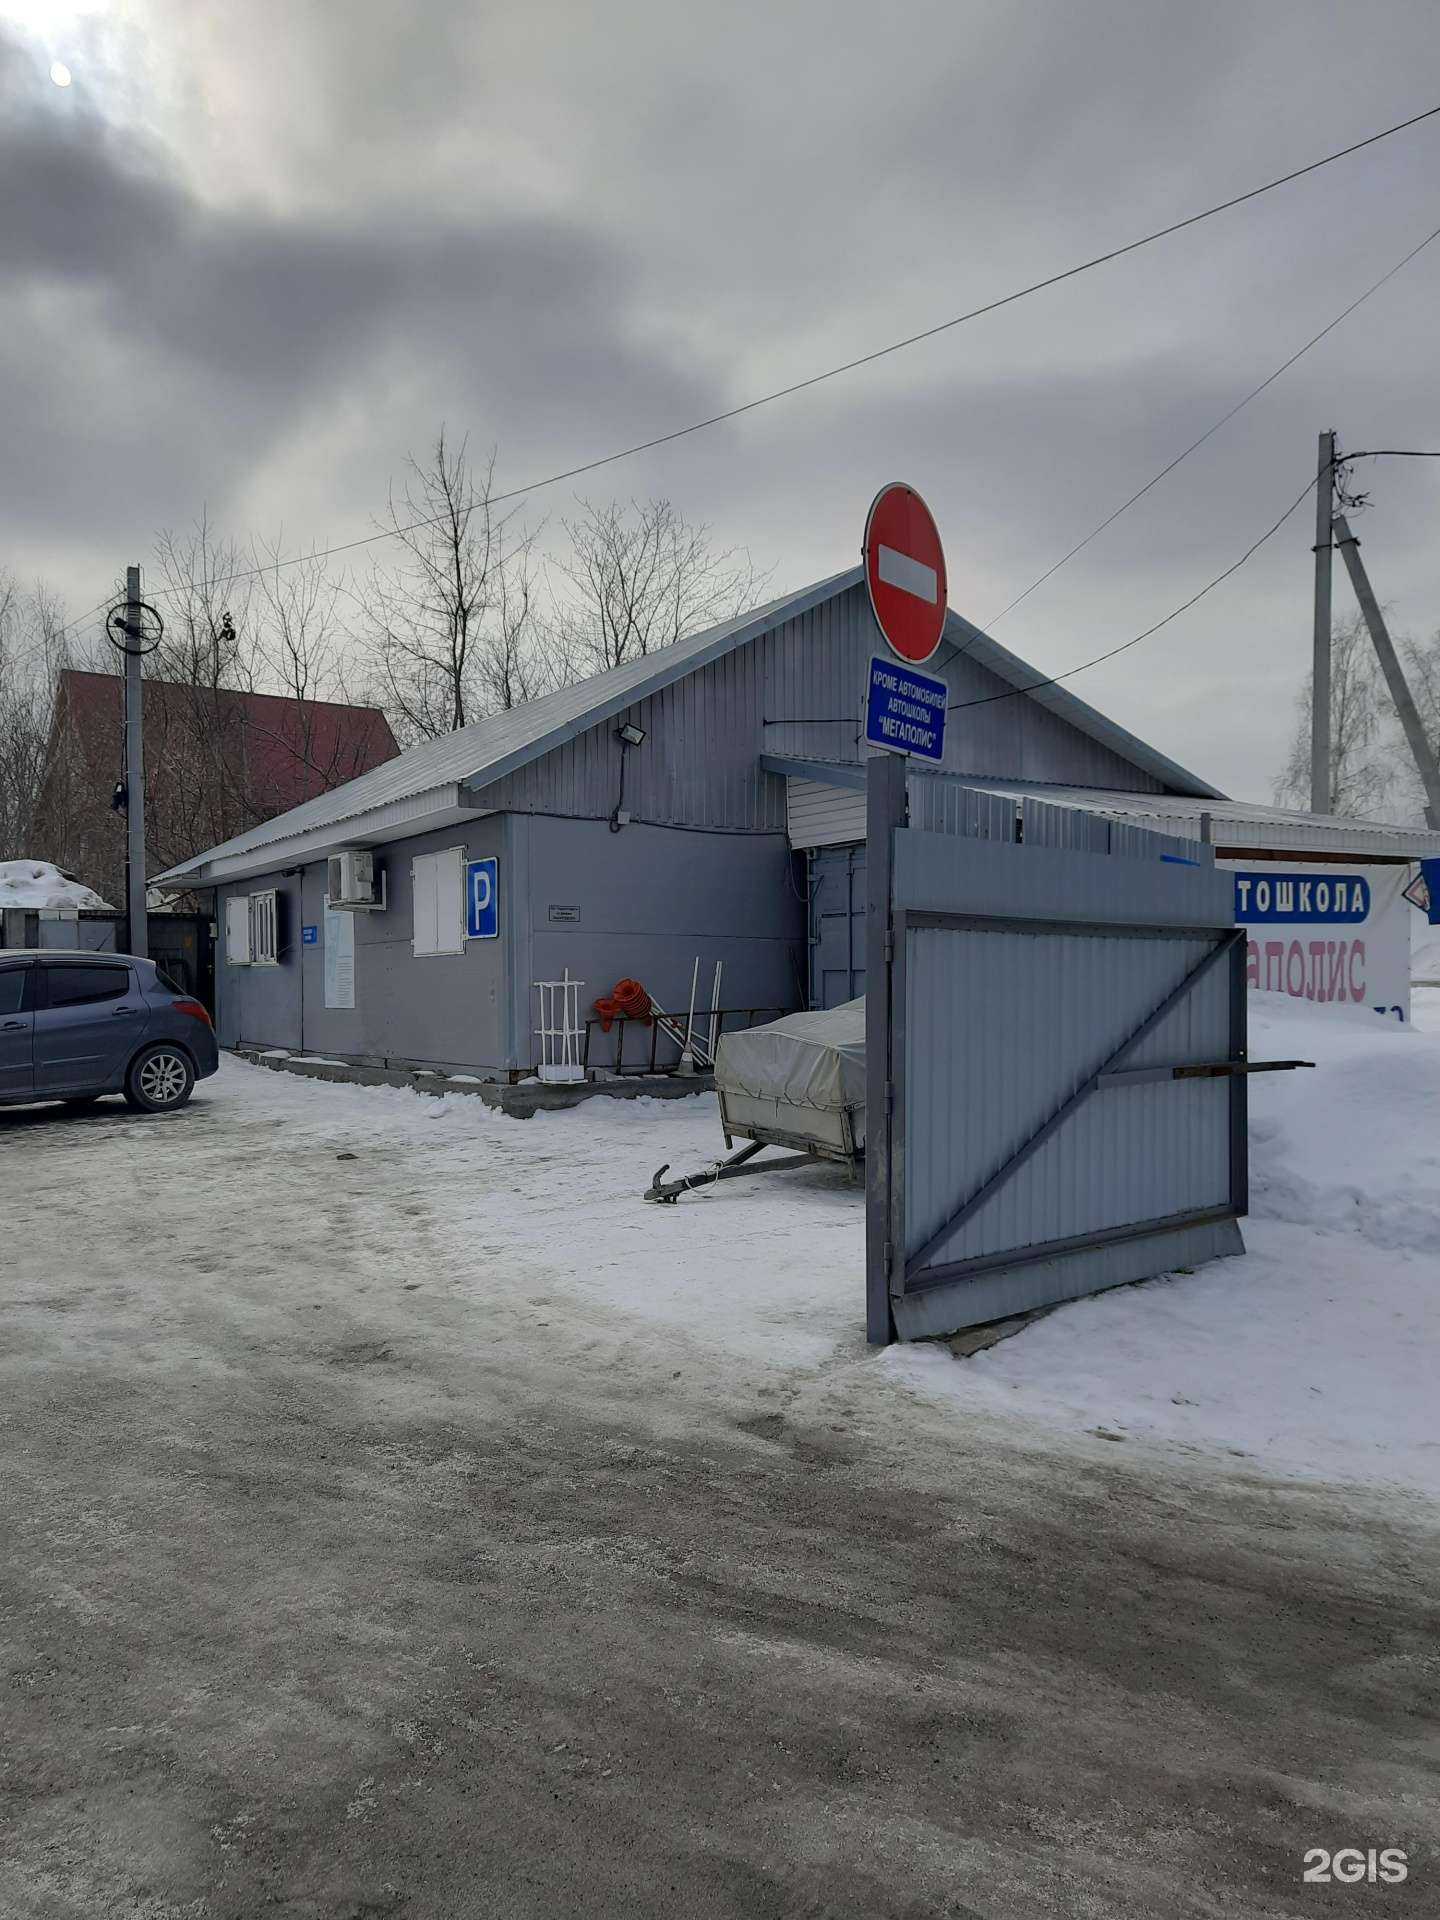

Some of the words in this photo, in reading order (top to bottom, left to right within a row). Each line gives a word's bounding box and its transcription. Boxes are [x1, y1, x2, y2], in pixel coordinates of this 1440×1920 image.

[873, 669, 898, 695] КРОМЕ
[898, 679, 946, 709] АВТОМОБИЛЕЙ
[888, 697, 931, 724] АВТОШКОЛЫ
[1237, 880, 1365, 913] ТОШКОЛА
